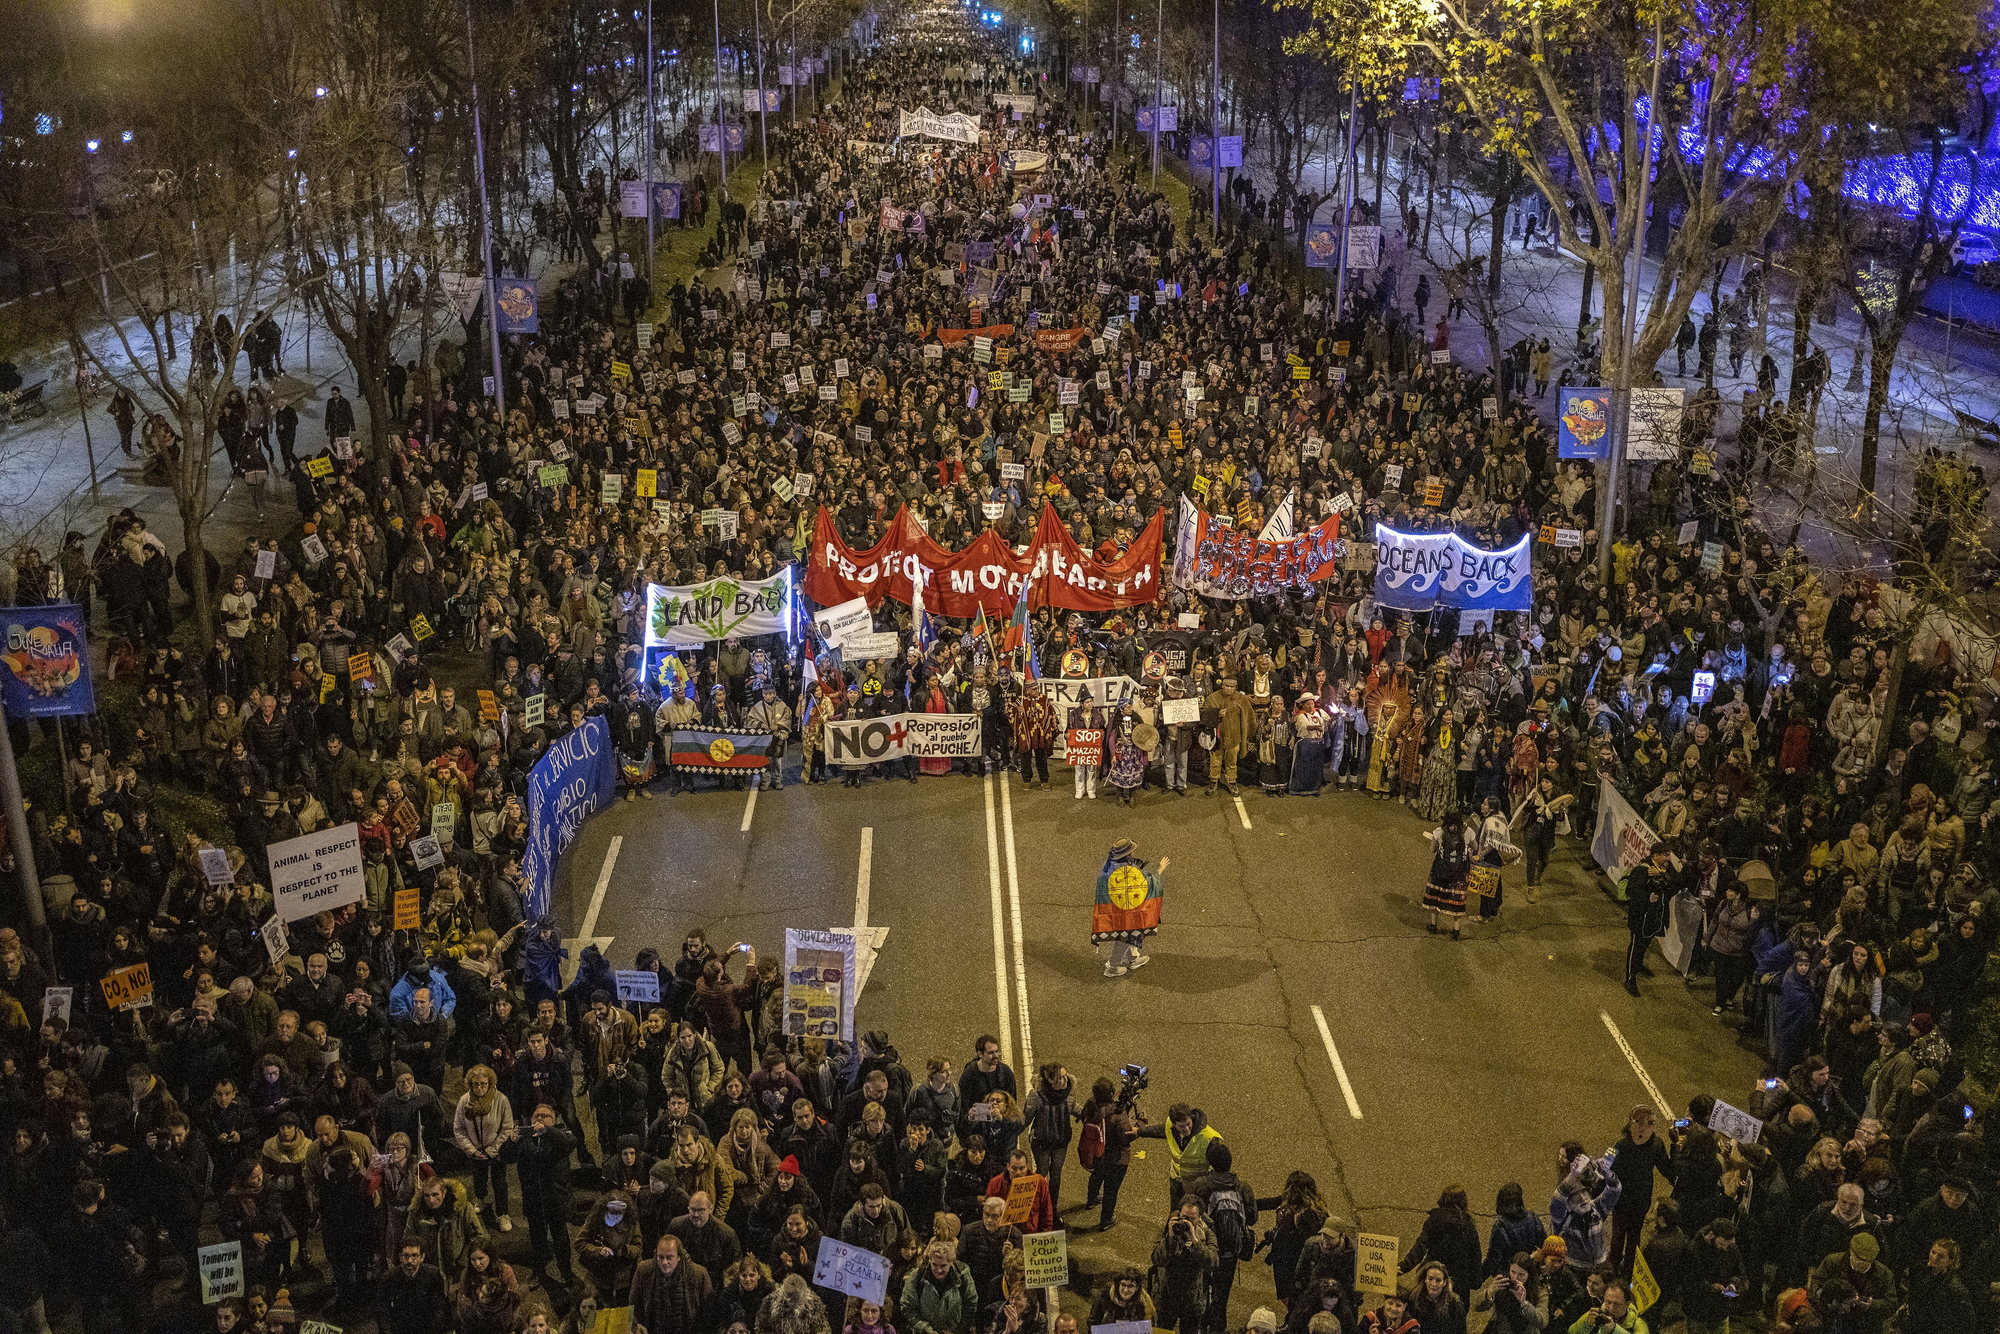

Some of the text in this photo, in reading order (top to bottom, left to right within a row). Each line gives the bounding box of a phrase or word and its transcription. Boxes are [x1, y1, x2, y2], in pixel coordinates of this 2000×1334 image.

[1039, 333, 1071, 341] SANGRE
[1208, 518, 1324, 562] RESPECT
[1378, 541, 1455, 574] OCEANS
[826, 542, 935, 588] PROTECT
[1460, 554, 1518, 581] BACK
[1052, 550, 1152, 596] EARTH
[664, 586, 788, 627] LAND BACK
[352, 661, 367, 670] CAN'T
[526, 697, 542, 708] CLEAN
[530, 706, 539, 715] AIR
[906, 718, 979, 735] Represión
[930, 732, 967, 743] al pueblo
[1074, 730, 1102, 743] STOP
[548, 722, 600, 784] SERVICIO
[1066, 747, 1101, 755] AMAZON
[1069, 756, 1098, 766] FIRES
[552, 778, 586, 825] CAMBIO
[436, 814, 451, 823] NEW
[274, 839, 357, 869] ANIMAL RESPECT
[312, 862, 323, 872] IS
[279, 865, 359, 895] RESPECT TO THE
[302, 884, 339, 902] PLANET
[128, 968, 151, 991] NO!
[1710, 1104, 1725, 1128] CLIMATIC
[1012, 1181, 1038, 1195] THE RICH
[1006, 1196, 1034, 1210] POLLUTE
[1011, 1212, 1025, 1223] LOT
[1031, 1236, 1059, 1247] Papá,
[1360, 1236, 1397, 1252] ECOCIDES:
[836, 1246, 848, 1257] NO
[1032, 1245, 1059, 1257] ¿Qué
[1369, 1251, 1385, 1263] USA,
[202, 1250, 239, 1266] Tomorrow
[854, 1253, 873, 1266] HAY
[1030, 1256, 1063, 1266] futuro
[210, 1266, 234, 1280] will be
[846, 1260, 882, 1284] PLANETA
[1026, 1265, 1068, 1276] me estás
[1364, 1263, 1388, 1276] CHINA,
[834, 1272, 844, 1288] B
[1026, 1274, 1068, 1285] dejando?
[209, 1286, 221, 1297] too
[1637, 1286, 1651, 1308] climate
[304, 1322, 340, 1334] PLAN
